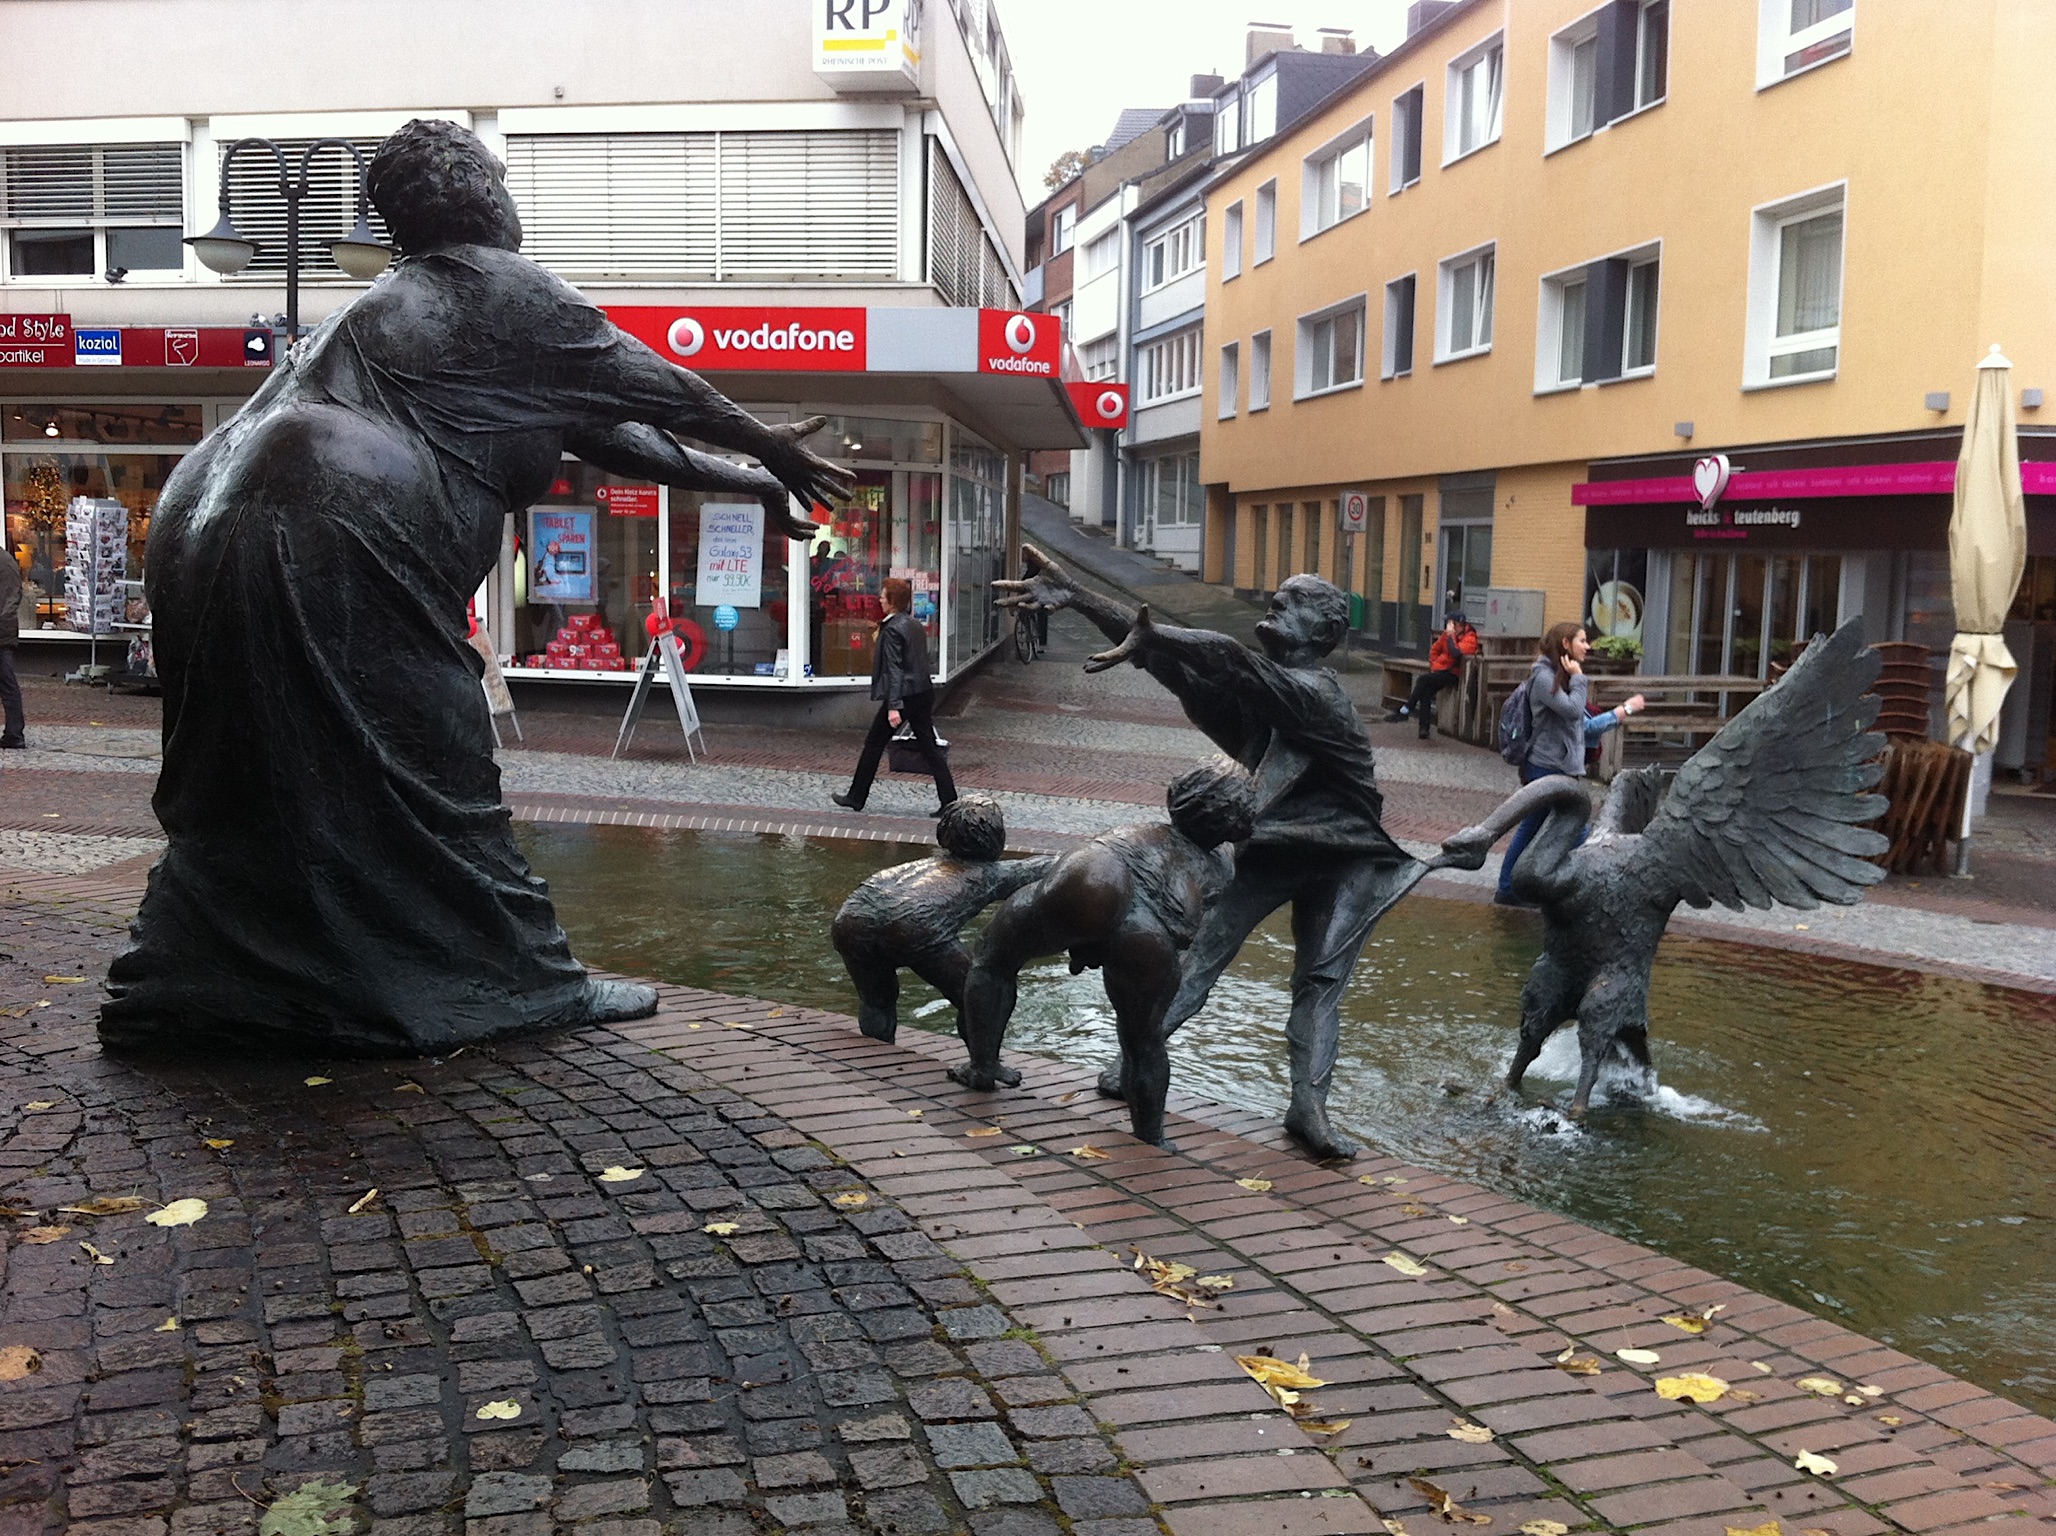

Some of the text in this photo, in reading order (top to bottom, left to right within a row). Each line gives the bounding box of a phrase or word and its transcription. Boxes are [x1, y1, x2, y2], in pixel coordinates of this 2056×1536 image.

[826, 0, 890, 30] RP
[822, 57, 888, 65] RHEINISCHE POST
[23, 317, 65, 342] Style
[713, 323, 854, 351] vodafone
[78, 335, 118, 350] koziol
[988, 355, 1050, 374] vodafone
[1351, 502, 1361, 515] 30
[1734, 507, 1800, 529] teutenberg
[709, 559, 748, 573] mit LTE
